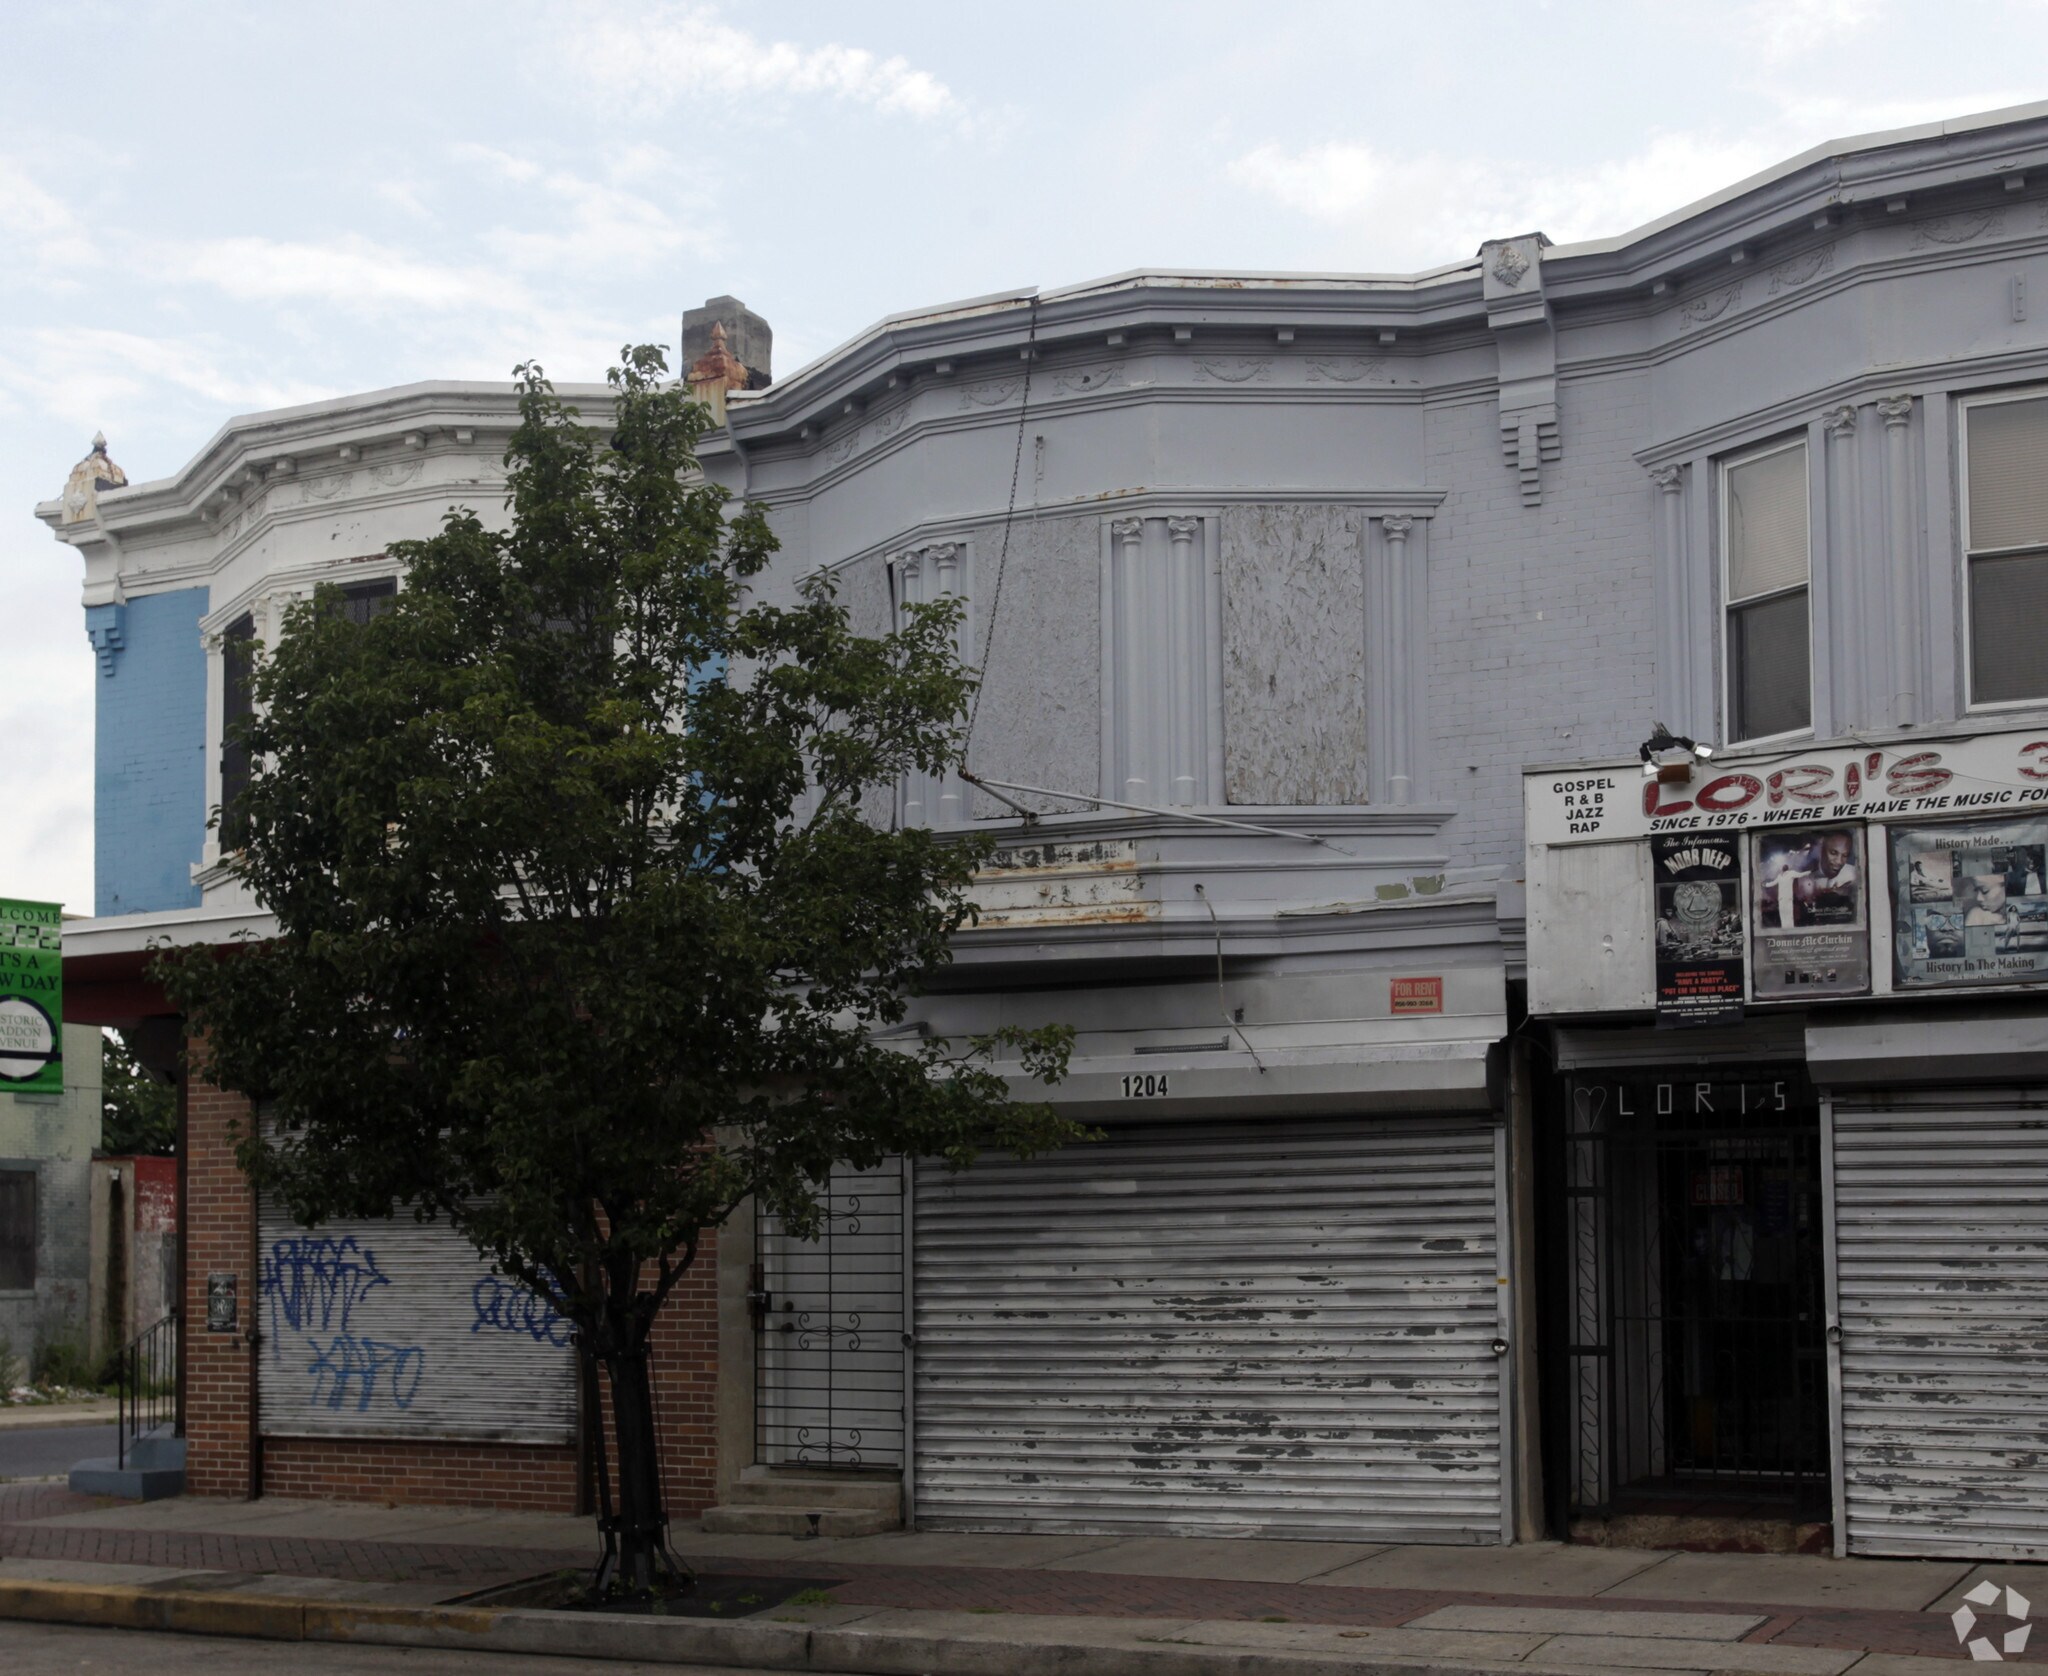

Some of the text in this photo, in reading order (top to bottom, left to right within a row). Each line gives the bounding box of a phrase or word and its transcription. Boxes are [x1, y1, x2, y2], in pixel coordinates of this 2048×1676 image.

[1553, 778, 1615, 793] GOSPEL
[1642, 752, 1954, 818] LORI'S
[1565, 793, 1604, 806] R & B
[1566, 807, 1604, 820] JAZZ
[1650, 816, 1701, 831] SINCE
[1706, 812, 1748, 827] 1976
[1763, 807, 1825, 823] WHERE
[1832, 804, 1860, 816] WE
[1863, 799, 1910, 814] HAVE
[1914, 795, 1950, 810] THE
[1953, 790, 2013, 806] MUSIC
[1570, 821, 1600, 834] RAP
[1663, 837, 1680, 848] The
[1936, 838, 1971, 850] History
[1664, 848, 1732, 875] MOBB DEEP
[1766, 937, 1800, 948] Donnie
[26, 955, 39, 969] A
[1926, 957, 2035, 973] History In The Making
[21, 973, 59, 991] DAY
[1395, 982, 1437, 996] FOR RENT
[1122, 1075, 1168, 1097] 1204
